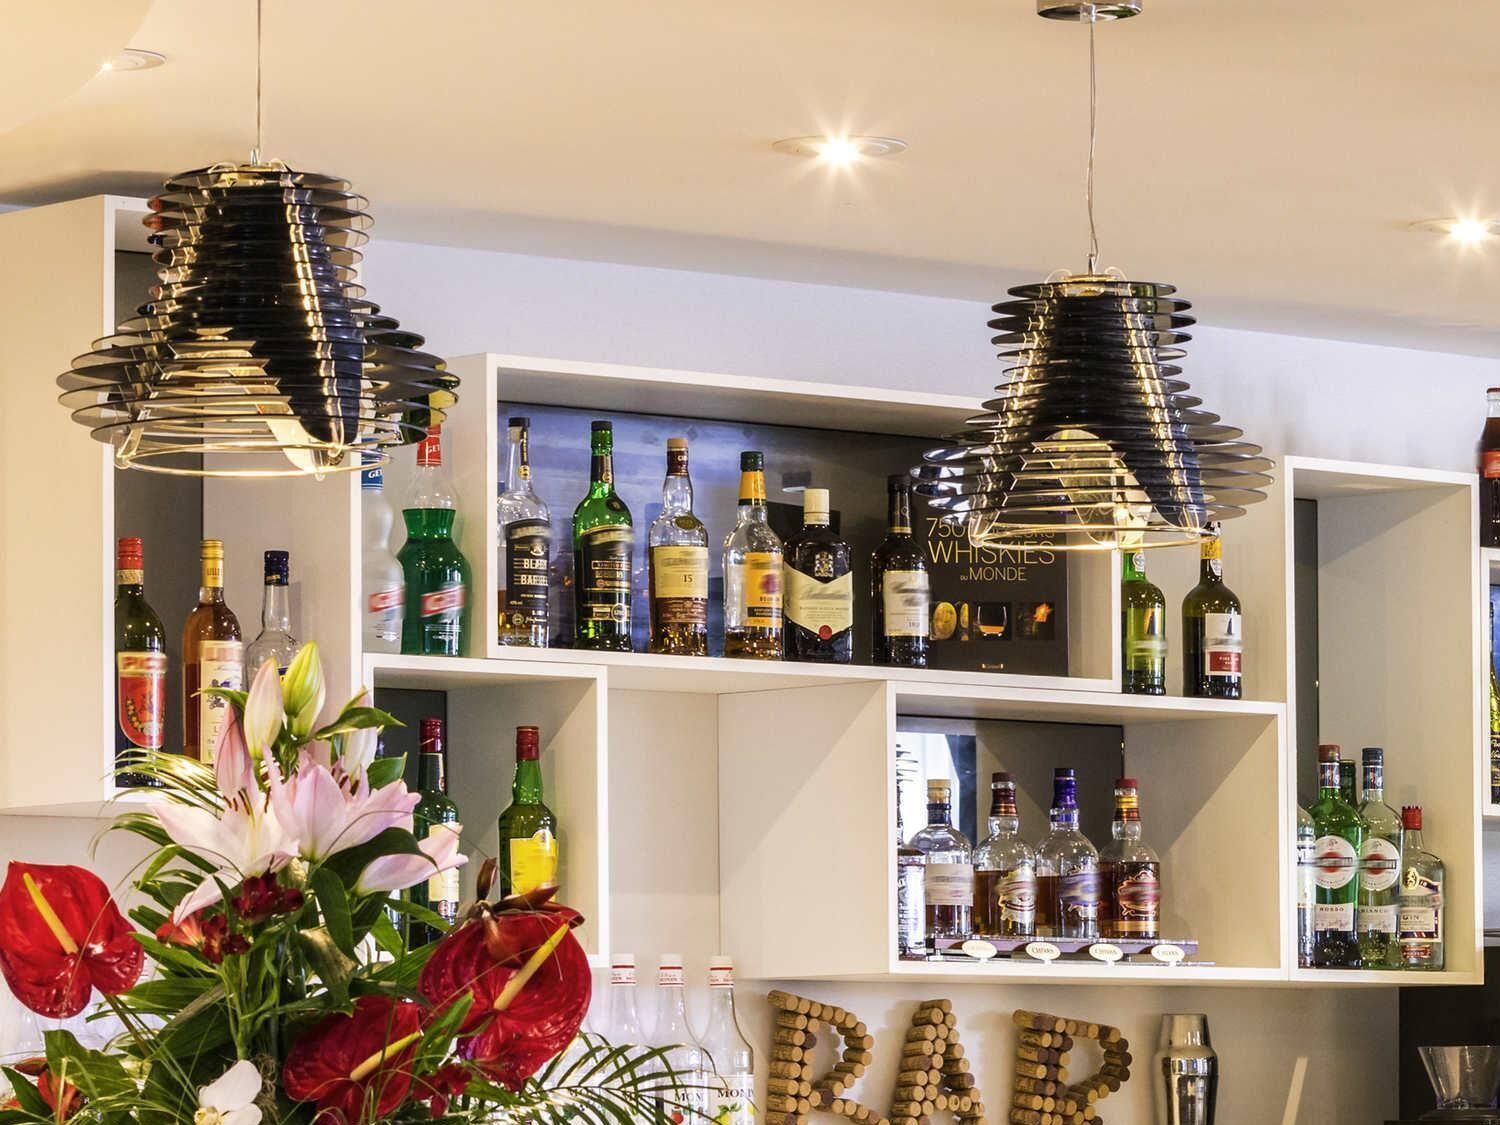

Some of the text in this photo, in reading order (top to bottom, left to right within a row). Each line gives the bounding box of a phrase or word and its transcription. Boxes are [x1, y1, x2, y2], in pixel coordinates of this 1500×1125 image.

[928, 540, 1055, 564] WHISKIES
[682, 575, 694, 584] 15
[969, 567, 1027, 581] MONDE
